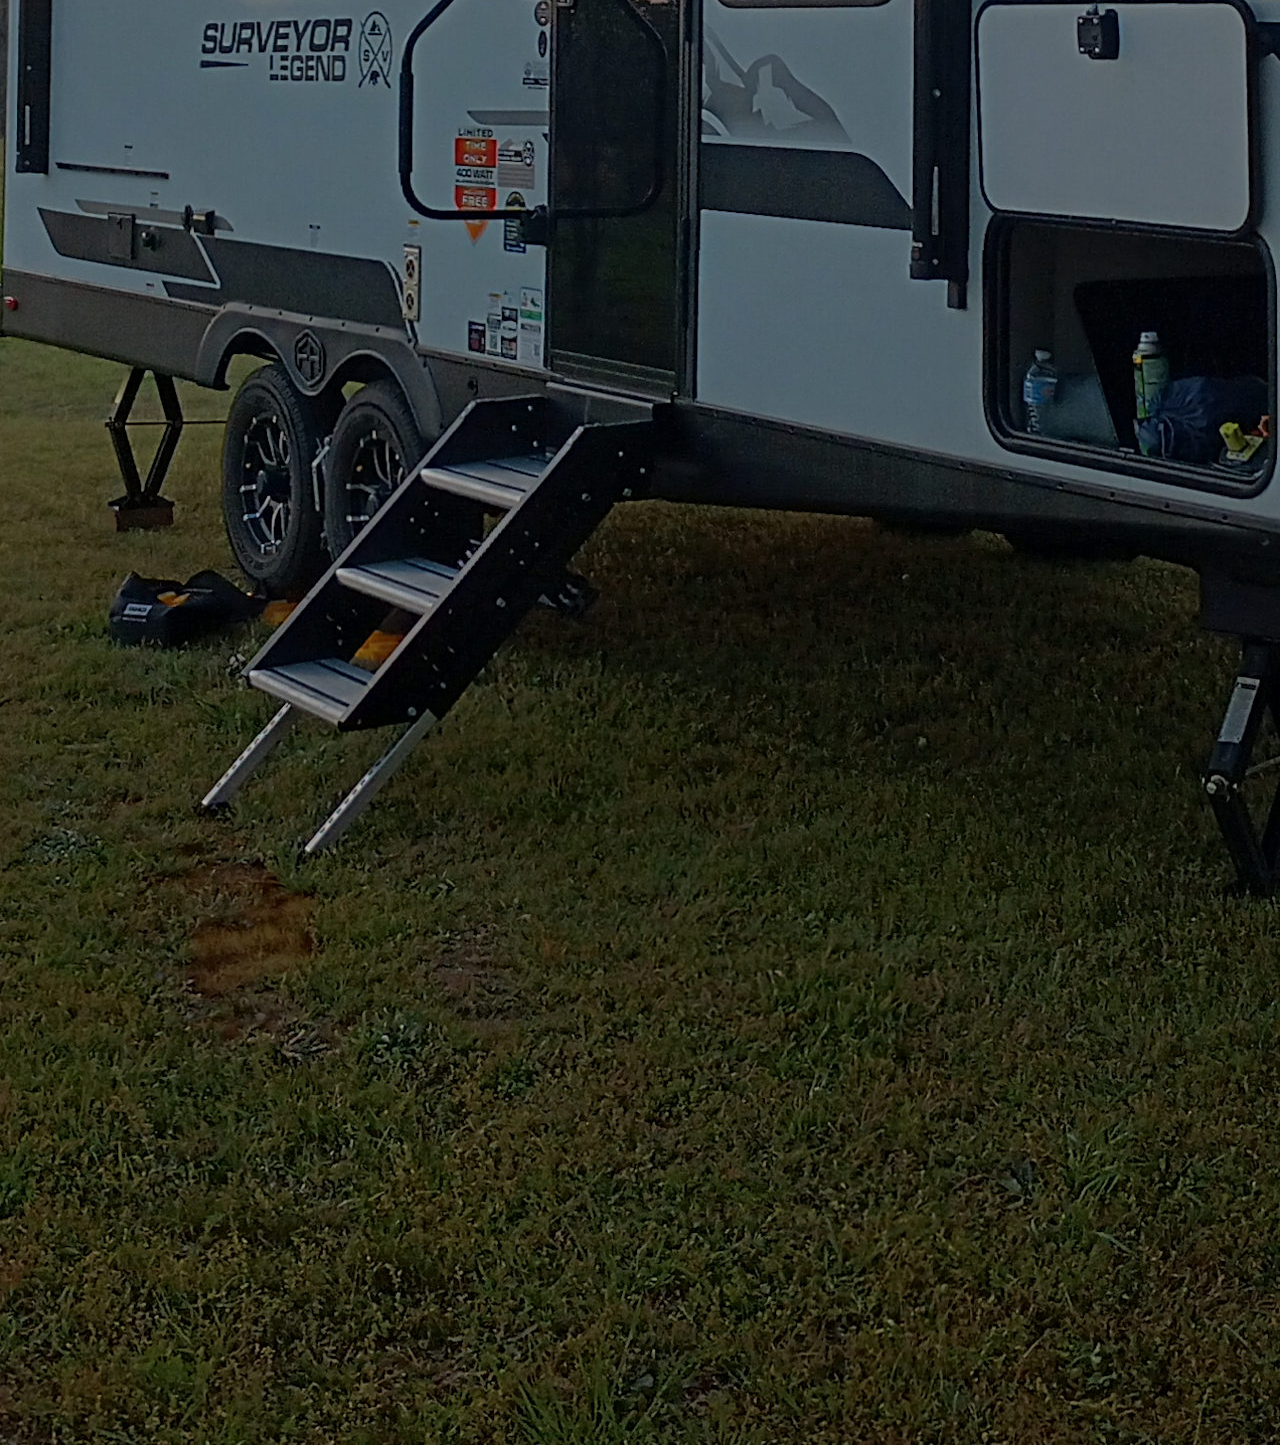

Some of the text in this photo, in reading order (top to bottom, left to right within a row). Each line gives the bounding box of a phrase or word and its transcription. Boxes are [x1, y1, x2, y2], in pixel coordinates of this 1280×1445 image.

[200, 17, 354, 55] SURVEYOR
[269, 54, 347, 83] LEGEND
[458, 127, 494, 139] LIMITED
[464, 140, 488, 152] TIME
[463, 153, 488, 164] ONLY
[456, 167, 472, 178] 400
[472, 168, 494, 180] WATT
[462, 194, 489, 208] FREE
